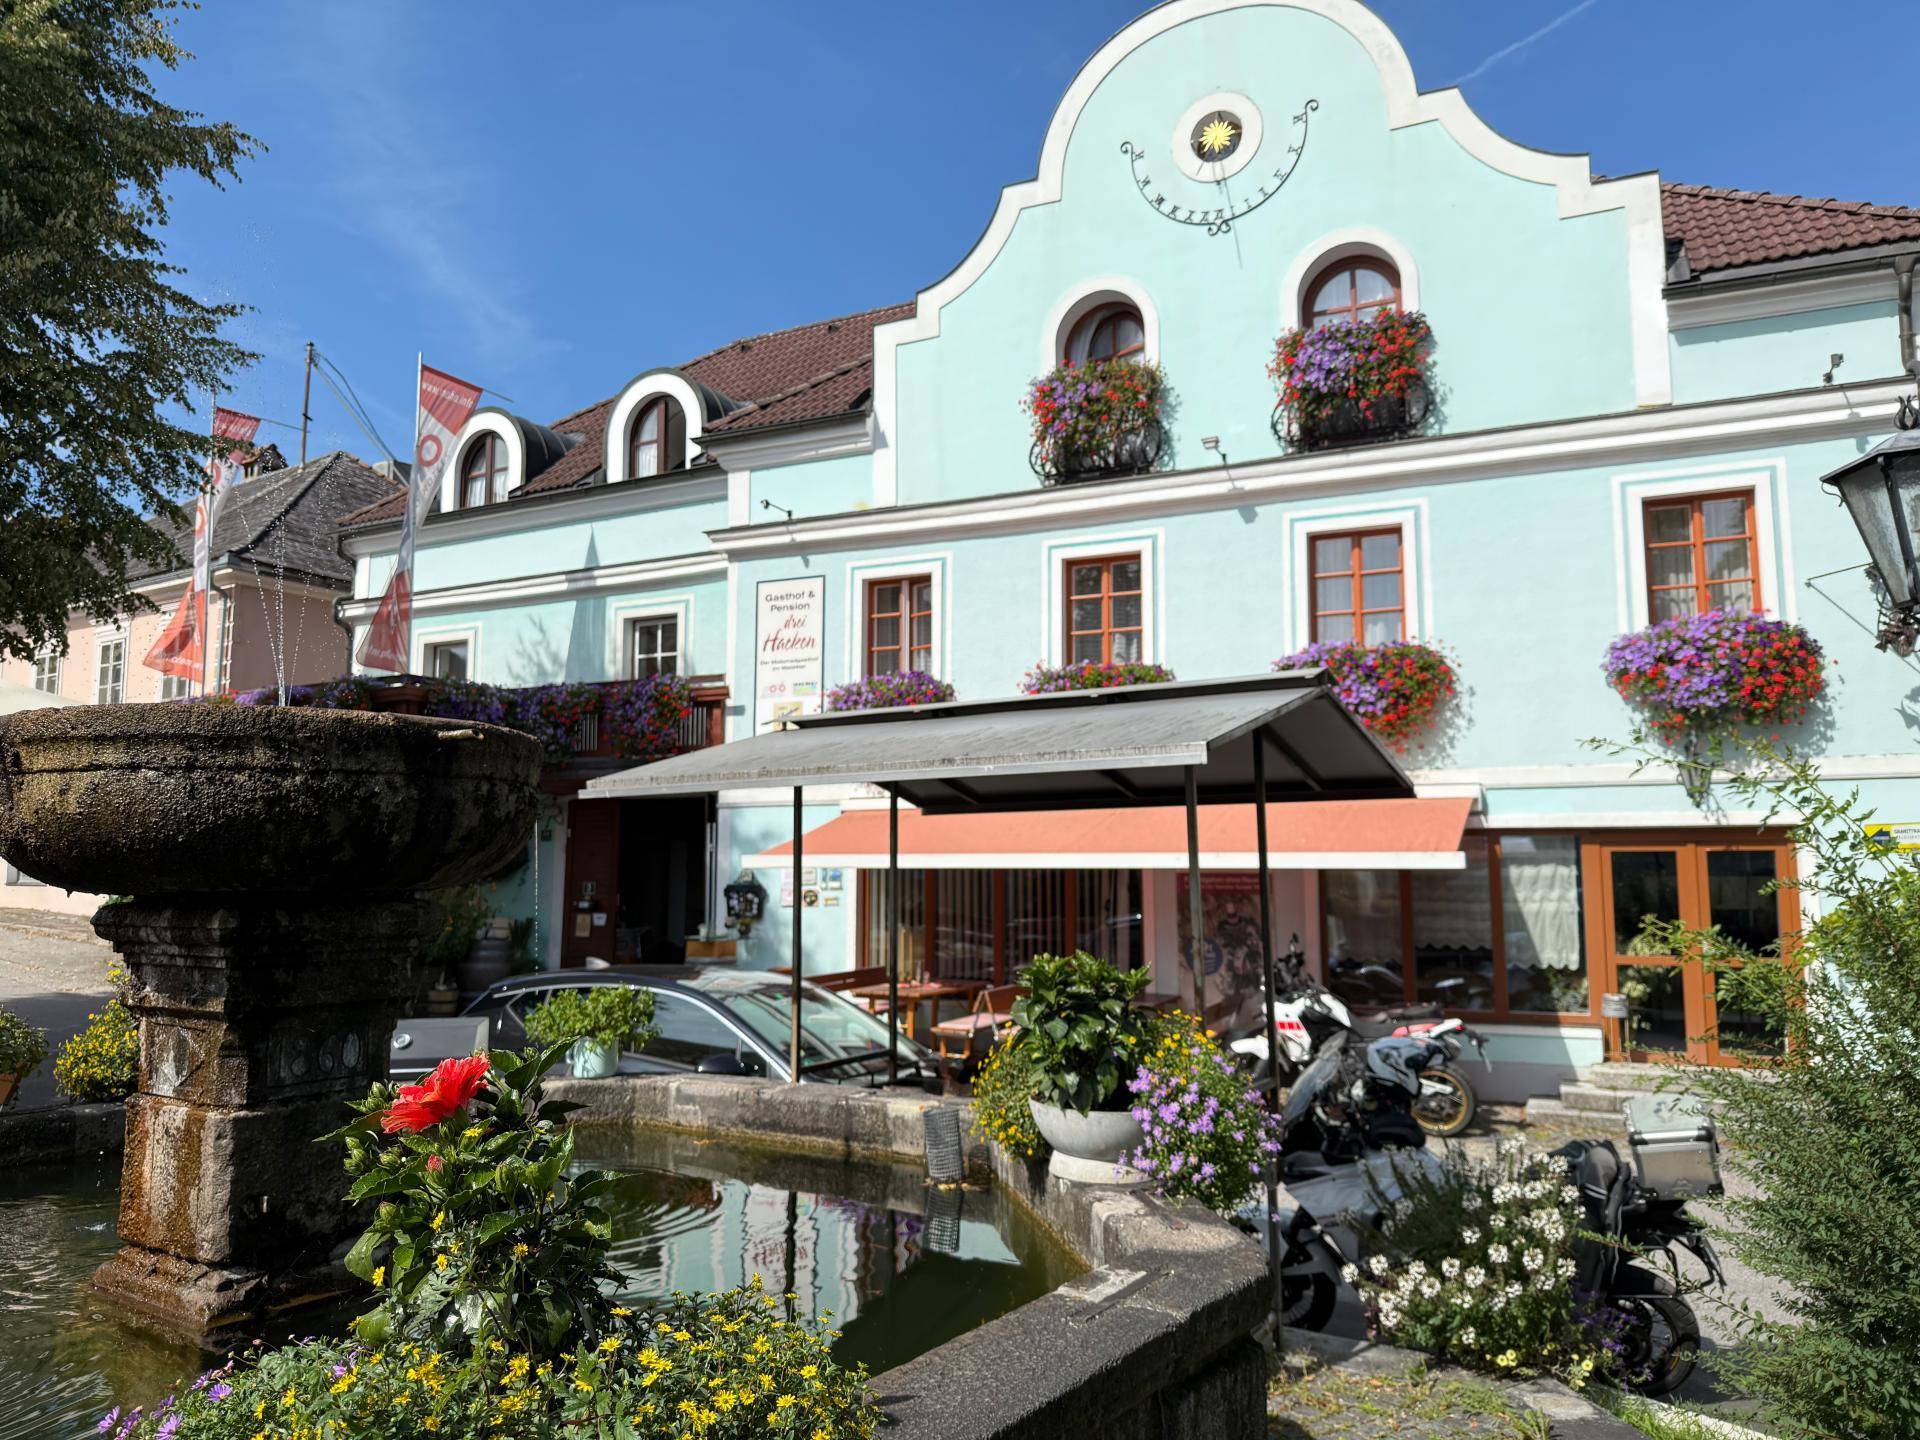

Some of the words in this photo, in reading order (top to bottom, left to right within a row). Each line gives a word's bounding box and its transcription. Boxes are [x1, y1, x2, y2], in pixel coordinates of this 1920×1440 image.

[765, 591, 805, 602] Gasthof
[808, 590, 815, 599] &
[770, 602, 810, 612] Pension
[763, 628, 816, 652] Hacken
[275, 1031, 361, 1080] 1860
